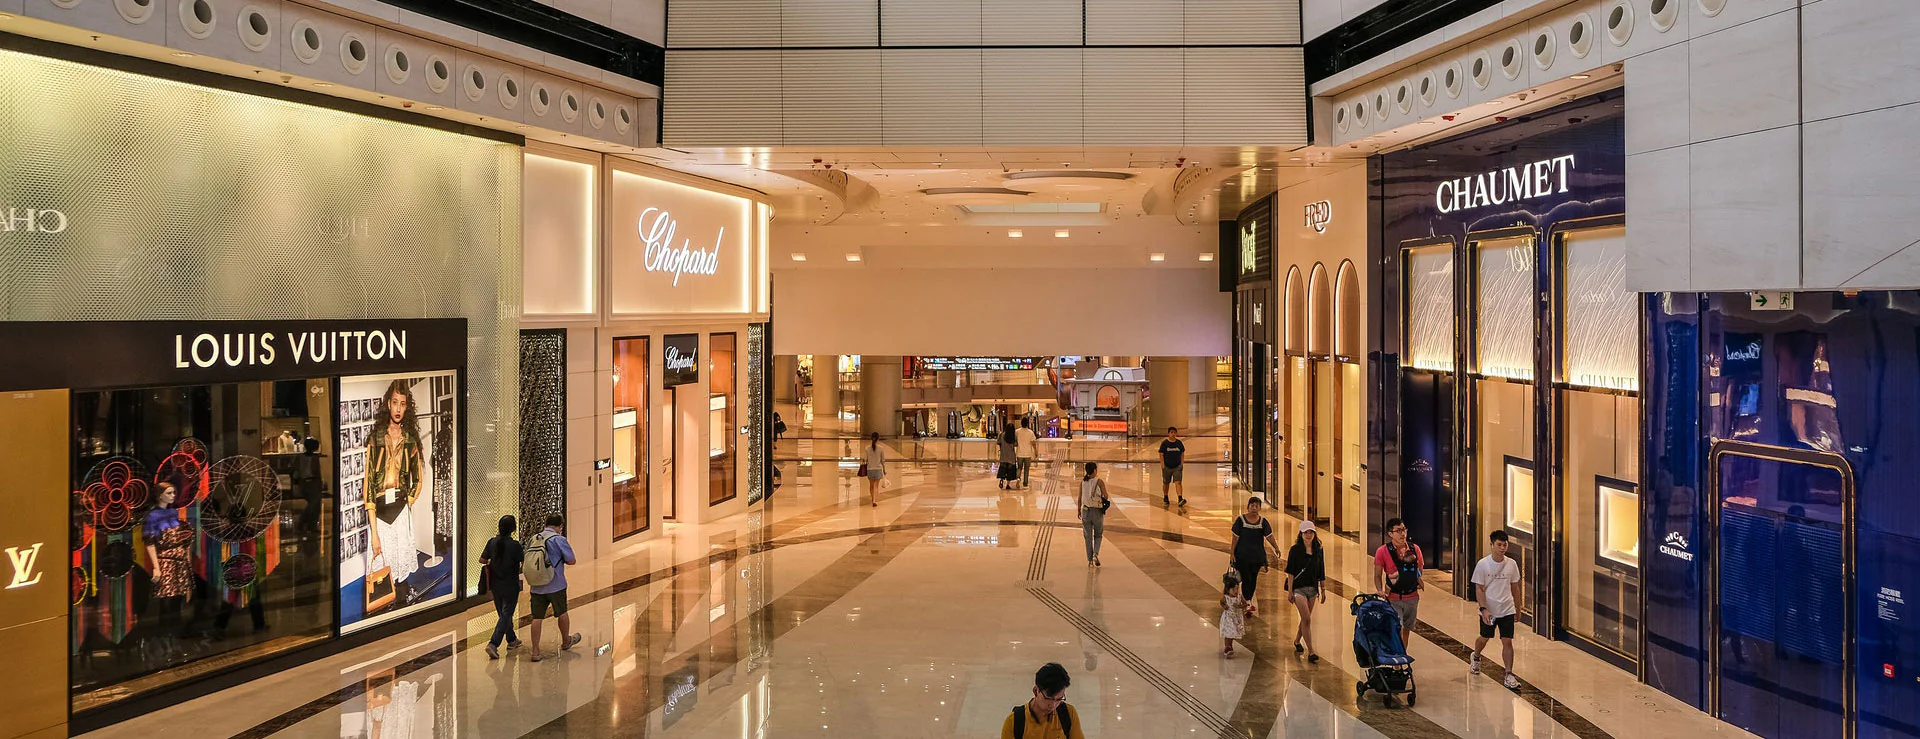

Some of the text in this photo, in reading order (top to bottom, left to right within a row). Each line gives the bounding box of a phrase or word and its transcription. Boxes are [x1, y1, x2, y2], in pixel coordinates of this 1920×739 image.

[1436, 154, 1576, 214] CHAUMET
[1304, 200, 1331, 233] FRED
[637, 206, 725, 287] Chopard
[175, 329, 407, 368] LOUIS VUITTON
[665, 345, 697, 374] Chopard
[1580, 373, 1635, 390] CHAUMET
[4, 542, 44, 589] LV
[1659, 544, 1693, 562] CHAUMET
